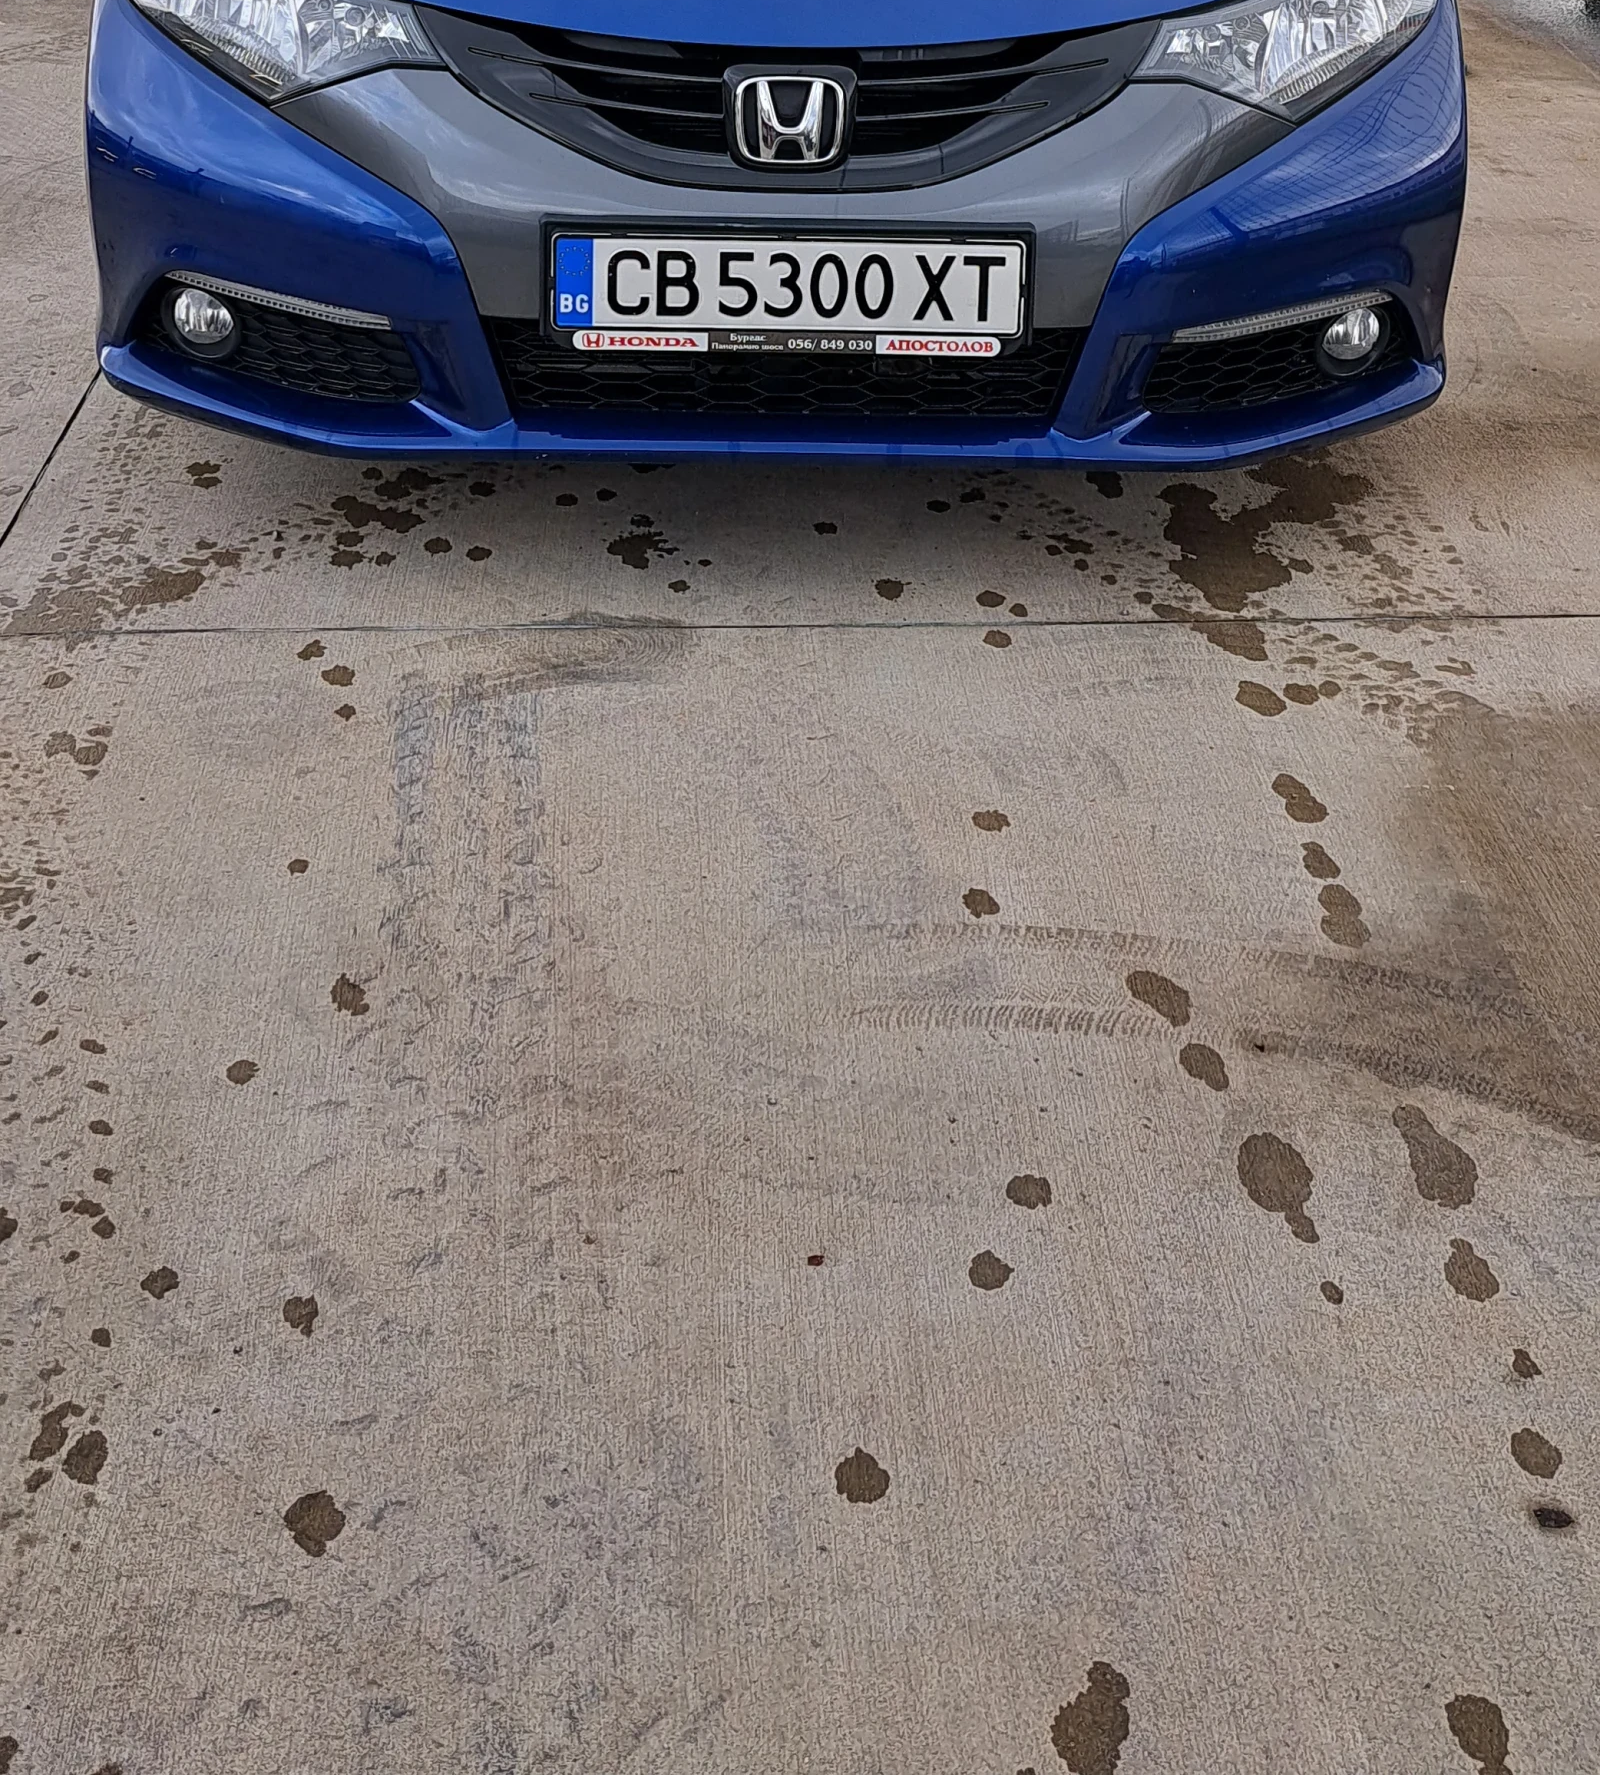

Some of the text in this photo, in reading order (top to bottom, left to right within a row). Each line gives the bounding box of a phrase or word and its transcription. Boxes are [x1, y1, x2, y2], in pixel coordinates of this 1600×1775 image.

[606, 248, 1007, 323] CB 5300 XT
[559, 293, 590, 314] BG
[608, 336, 700, 347] HONDA
[787, 338, 873, 351] 056/ 849 030
[885, 339, 994, 353] АПОСТОЛОВ
